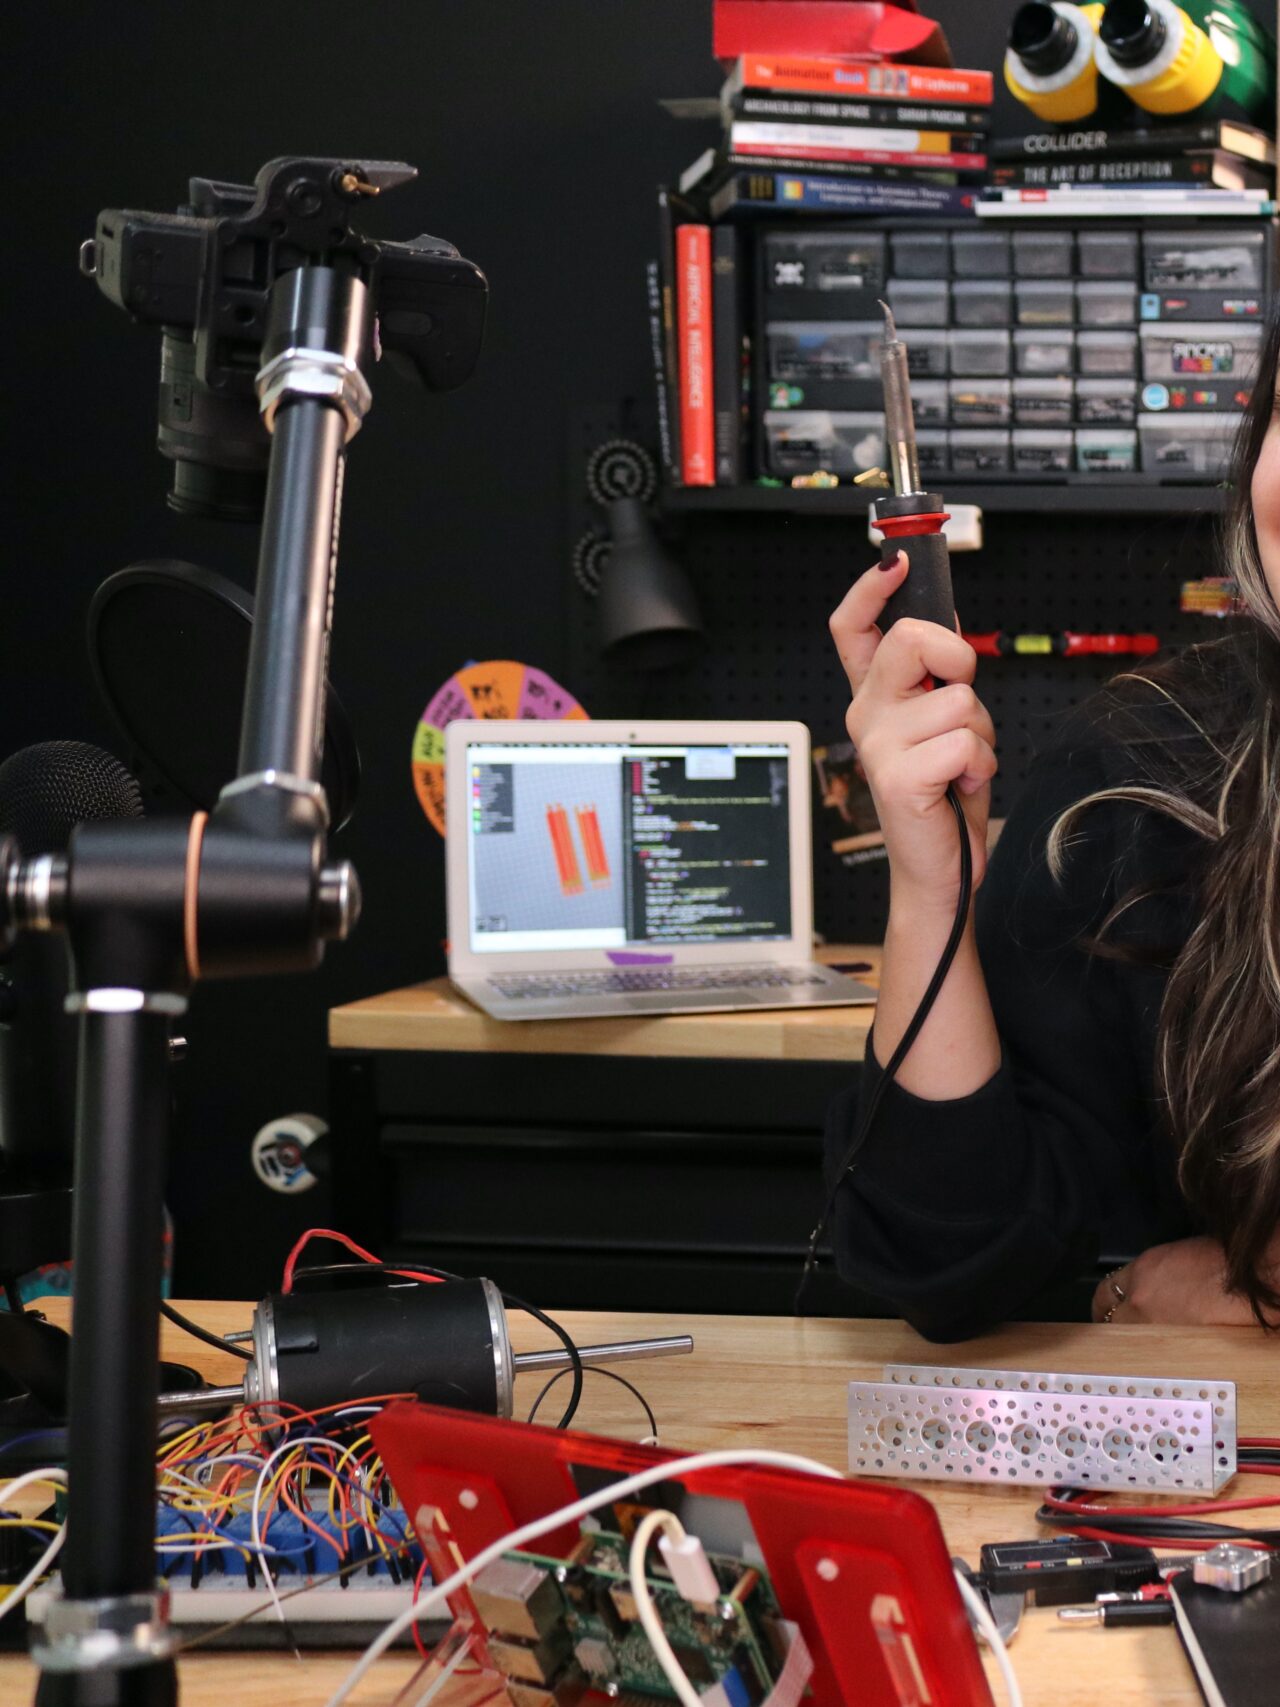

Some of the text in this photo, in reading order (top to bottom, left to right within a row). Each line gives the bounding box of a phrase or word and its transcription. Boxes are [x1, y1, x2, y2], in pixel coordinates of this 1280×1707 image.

[813, 102, 840, 117] FROM
[842, 104, 870, 119] SPACE
[1023, 131, 1107, 153] COLLIDER
[1024, 166, 1046, 183] THE
[1051, 165, 1075, 182] ART
[1078, 163, 1095, 180] OF
[1099, 161, 1173, 180] DECEPTION
[688, 329, 703, 409] INTELLIGENCE
